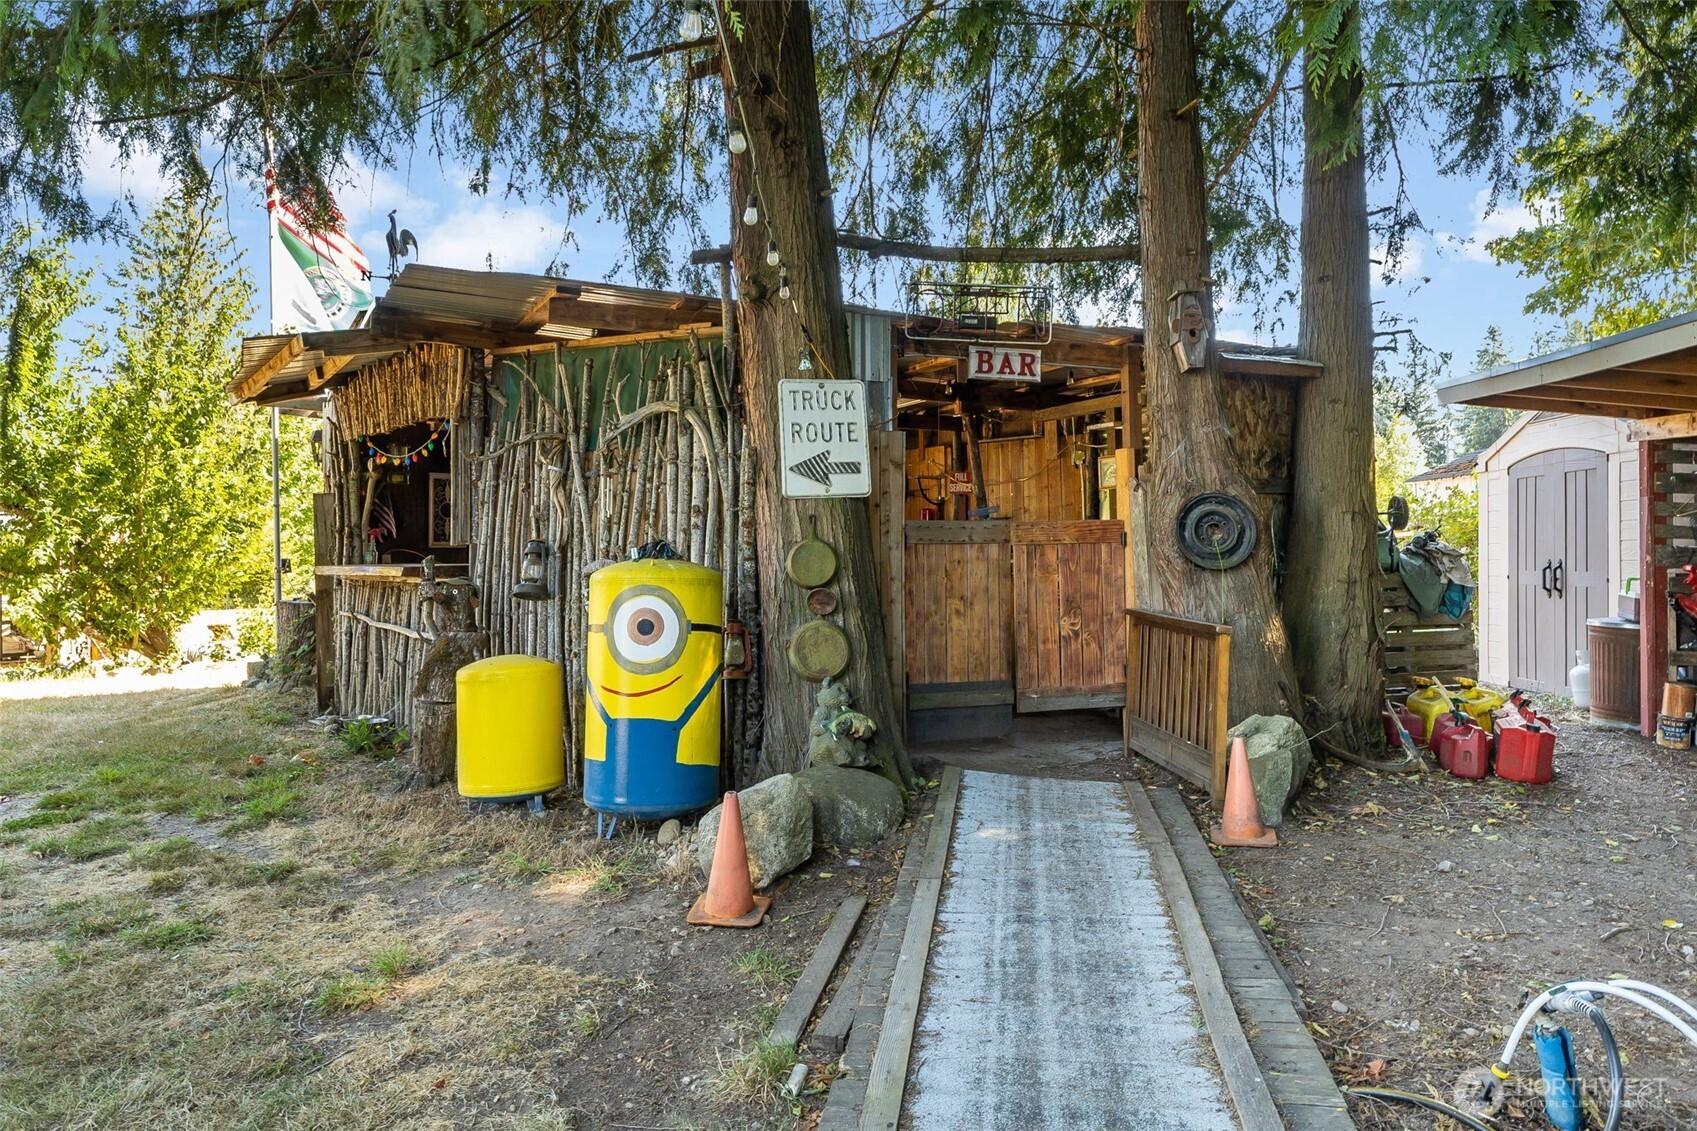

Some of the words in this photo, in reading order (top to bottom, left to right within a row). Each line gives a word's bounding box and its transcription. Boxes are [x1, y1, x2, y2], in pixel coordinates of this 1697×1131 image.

[975, 350, 1036, 377] BAR
[788, 389, 856, 411] TRUCK
[790, 421, 858, 443] ROUTE
